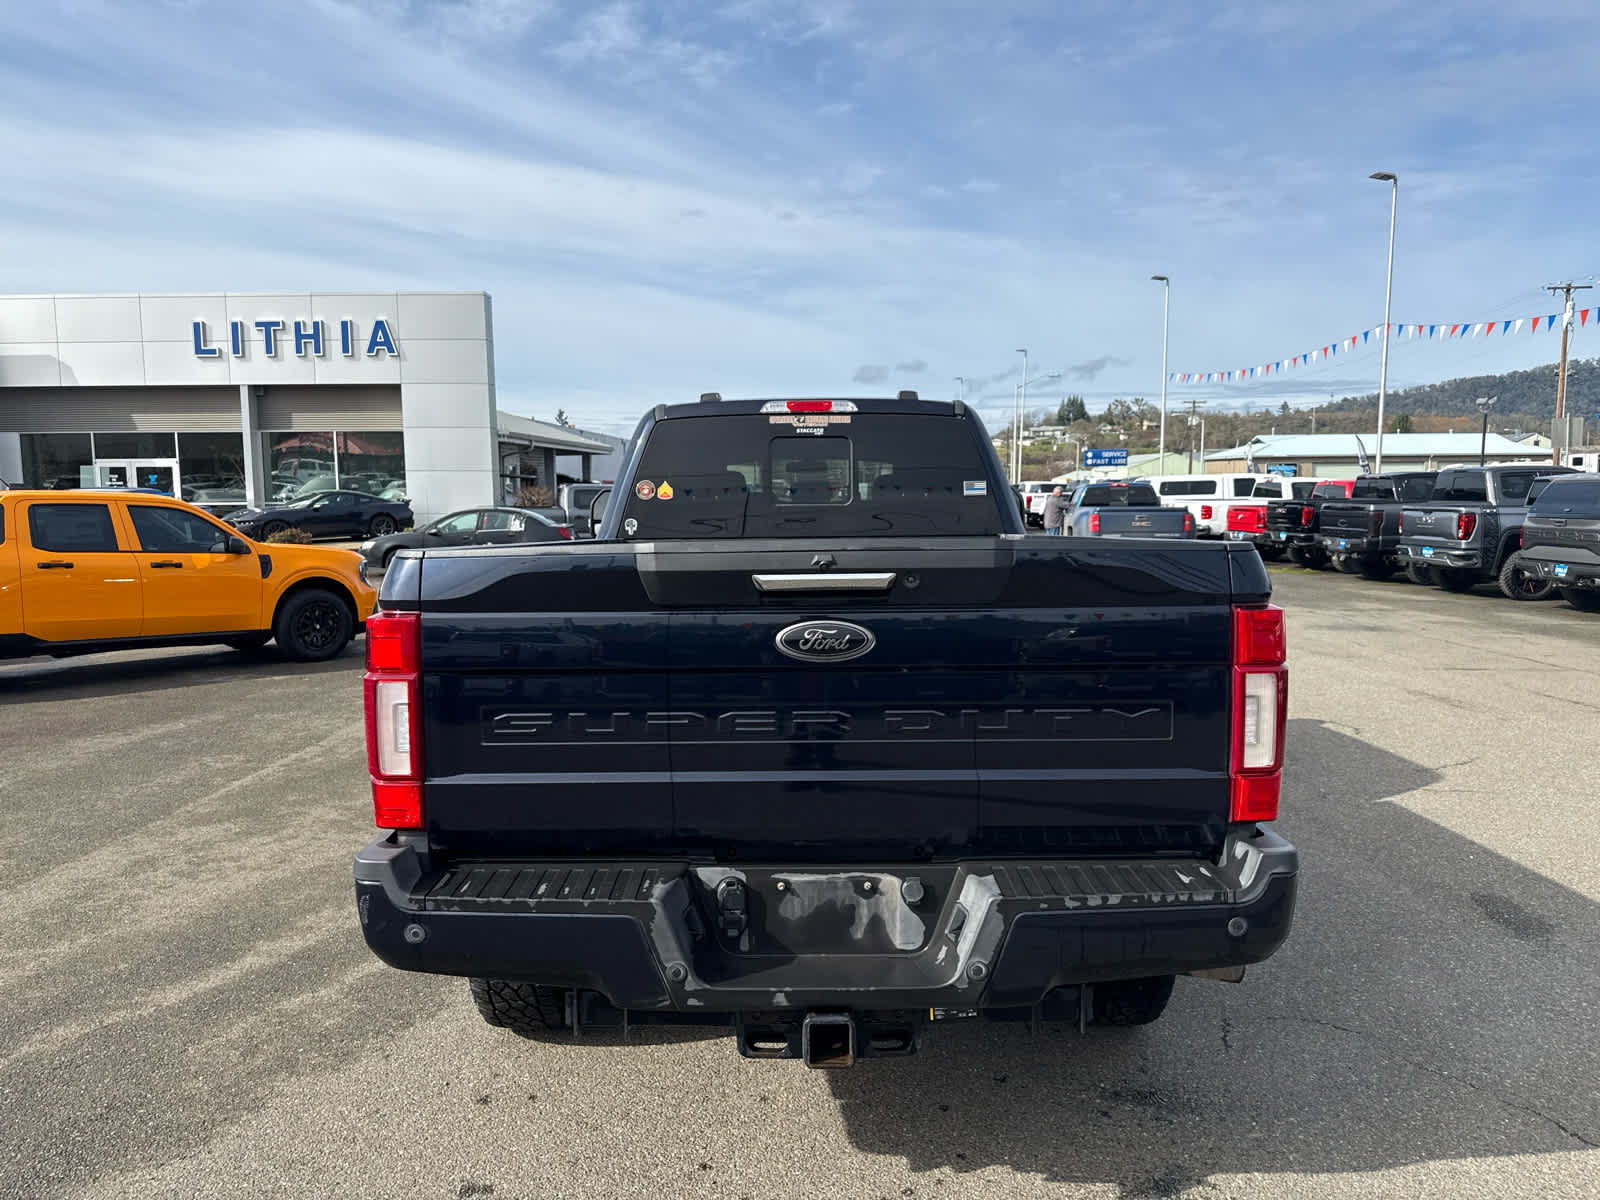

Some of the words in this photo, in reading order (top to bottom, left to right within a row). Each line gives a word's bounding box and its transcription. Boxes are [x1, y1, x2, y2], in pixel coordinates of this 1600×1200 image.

[192, 319, 400, 358] LITHIA
[799, 628, 851, 650] Ford
[493, 710, 852, 735] SUPER
[881, 707, 1161, 732] DUTY
